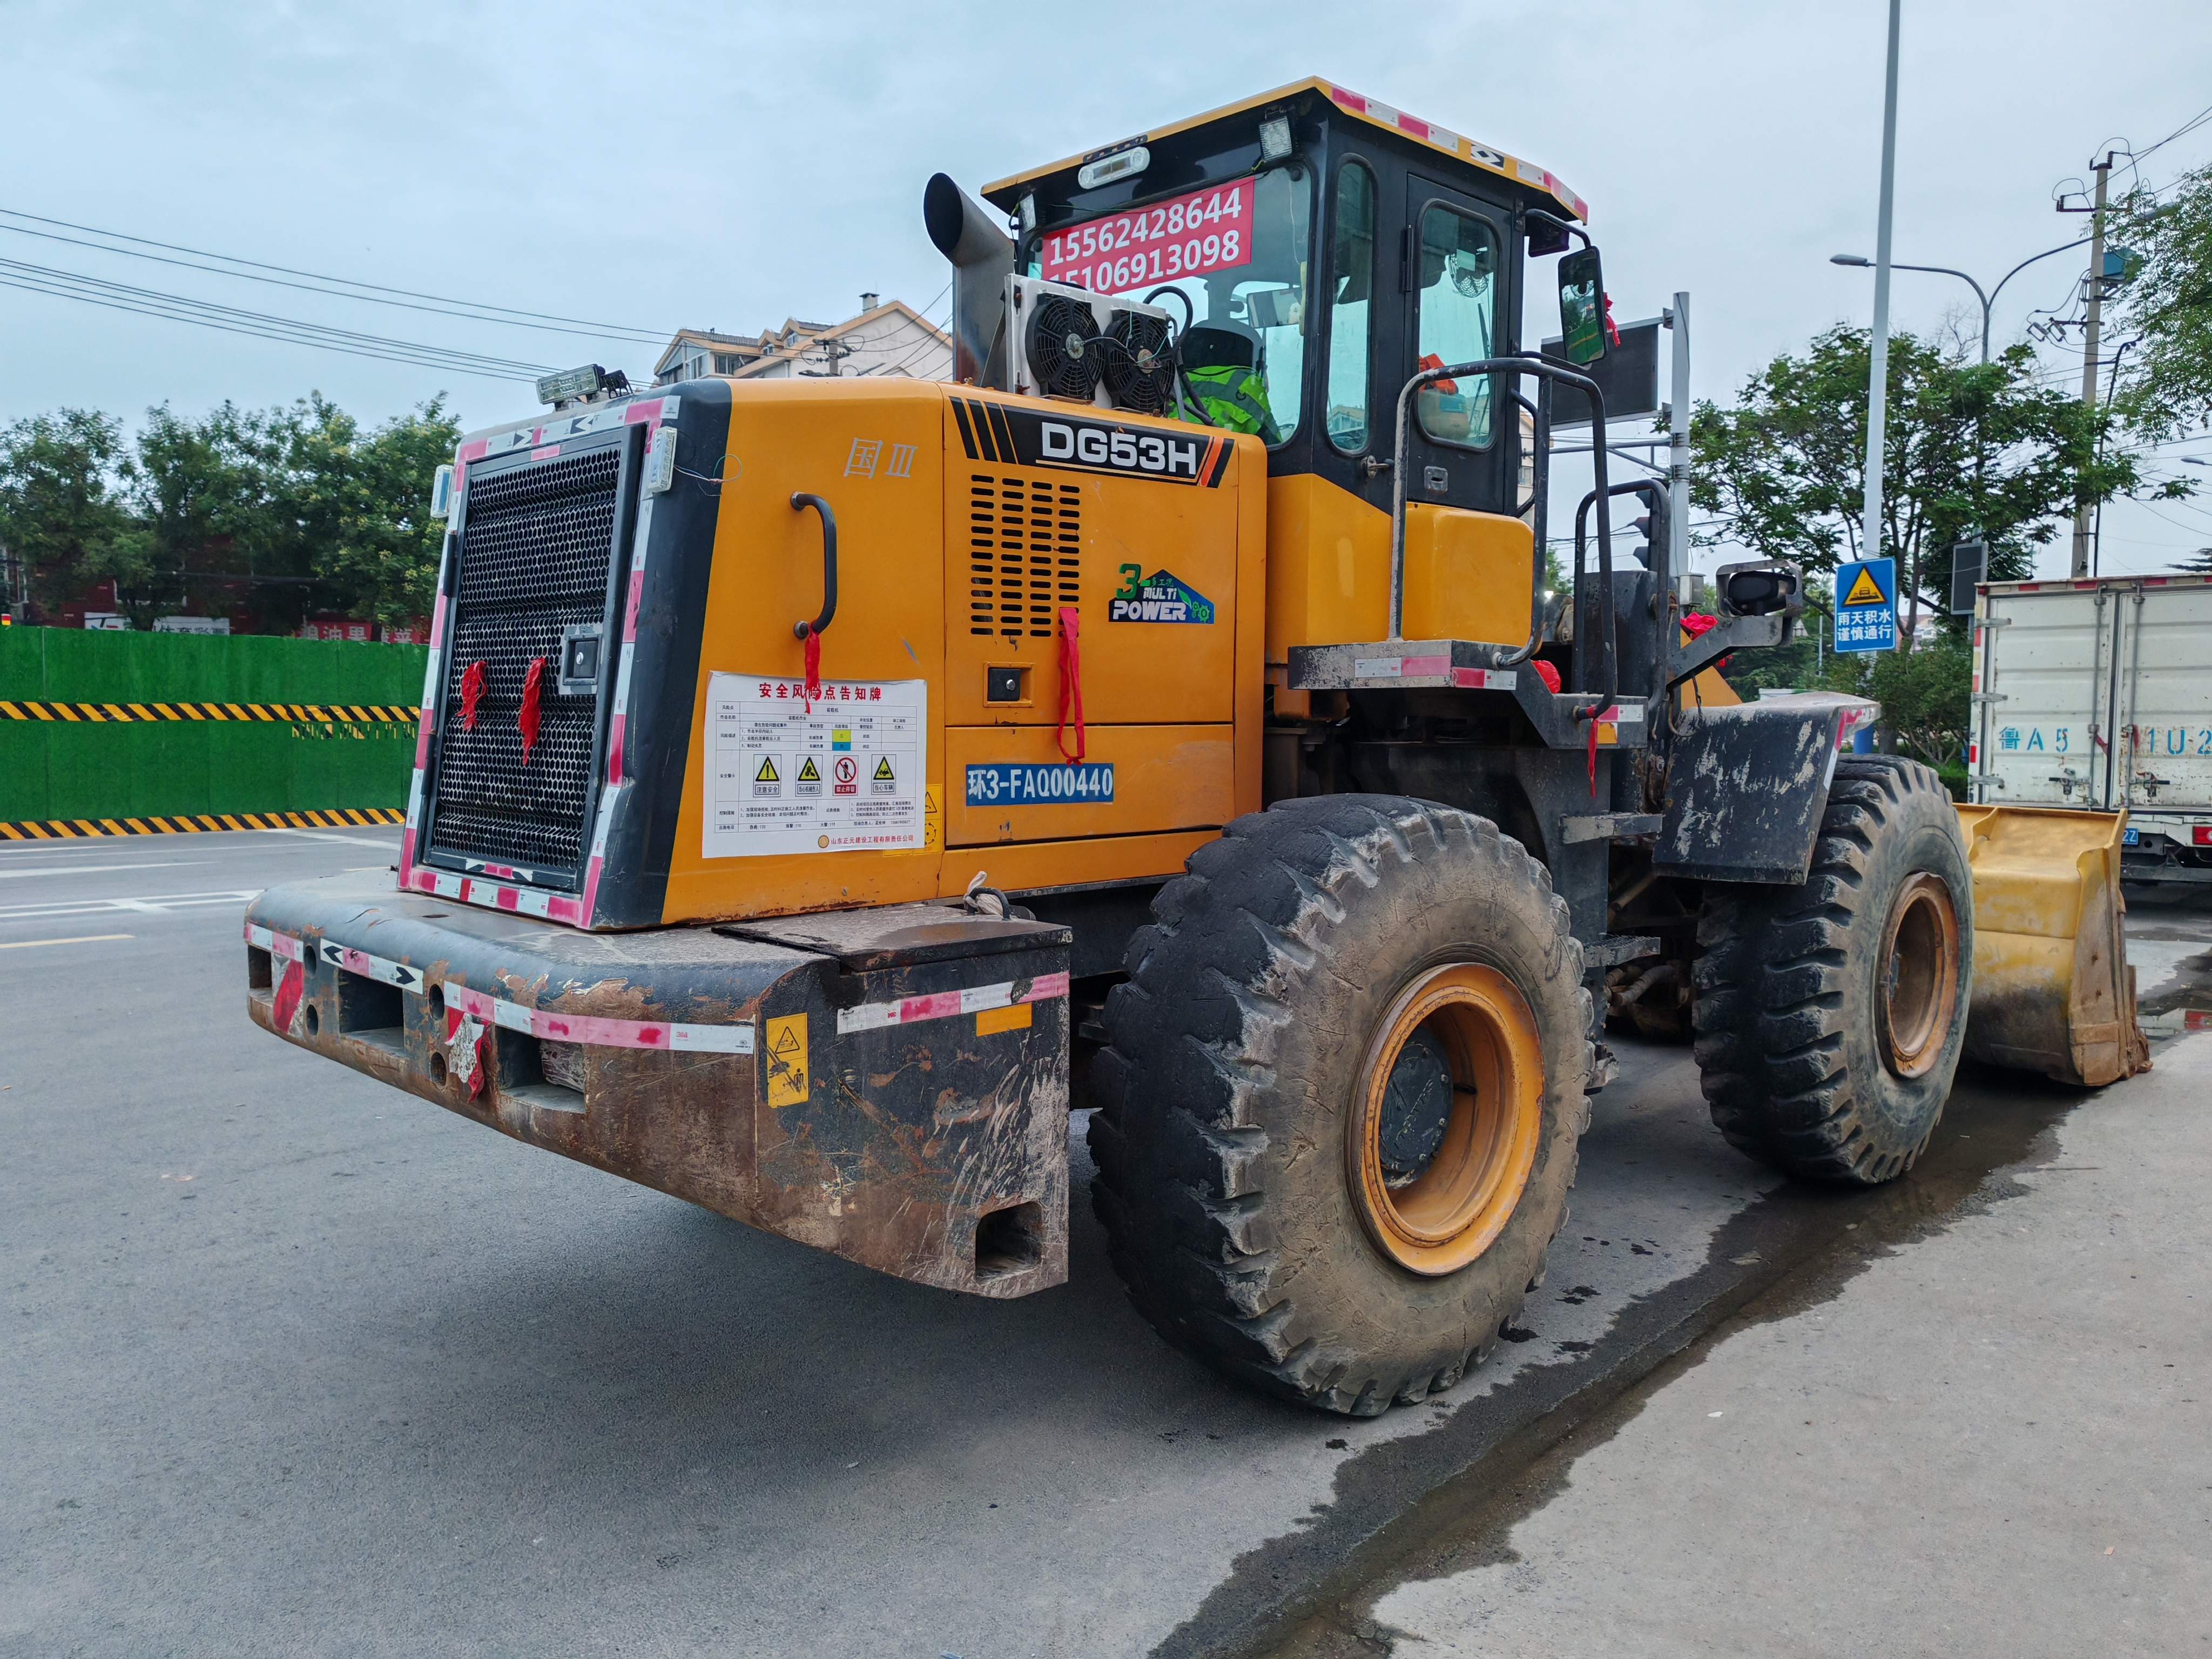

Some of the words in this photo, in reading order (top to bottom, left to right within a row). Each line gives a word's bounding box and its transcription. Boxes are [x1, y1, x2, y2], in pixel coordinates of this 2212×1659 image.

[1050, 187, 1242, 265] 15562428644
[1050, 230, 1239, 293] 106913098
[1042, 422, 1196, 475] DG53H
[1112, 601, 1186, 621] POWER
[1837, 609, 1892, 626] 雨天积水
[1837, 624, 1892, 641] 谨慎通行
[968, 768, 1113, 800] 环3-FAQ00440
[831, 835, 913, 845] 山东正元建设工程有限责任公司
